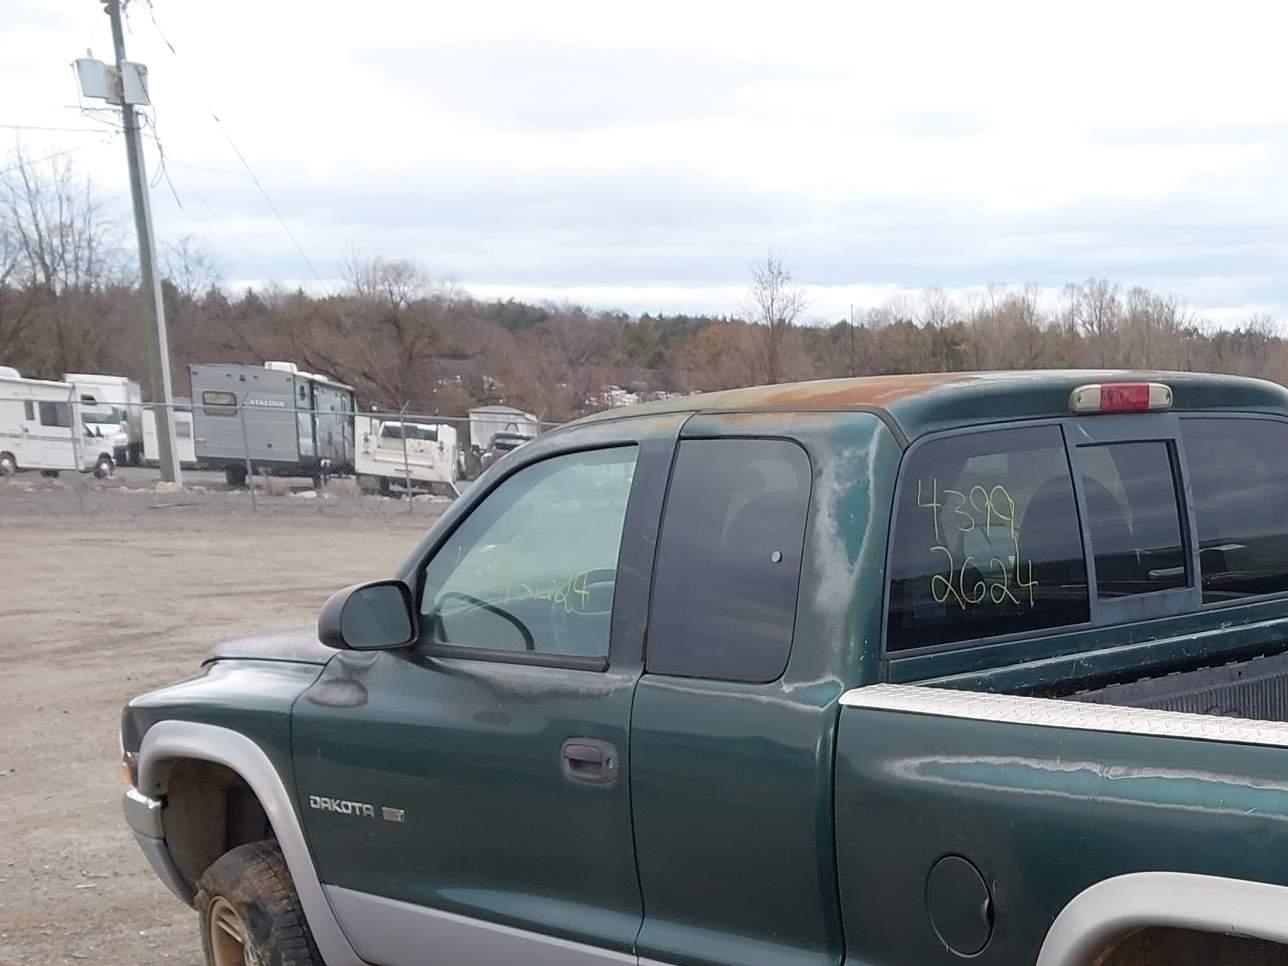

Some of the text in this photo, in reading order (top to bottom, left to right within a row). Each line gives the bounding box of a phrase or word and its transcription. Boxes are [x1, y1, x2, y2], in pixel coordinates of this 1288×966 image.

[917, 478, 1015, 544] 4399
[929, 536, 1039, 611] 2624
[308, 795, 375, 818] DAKOTA
